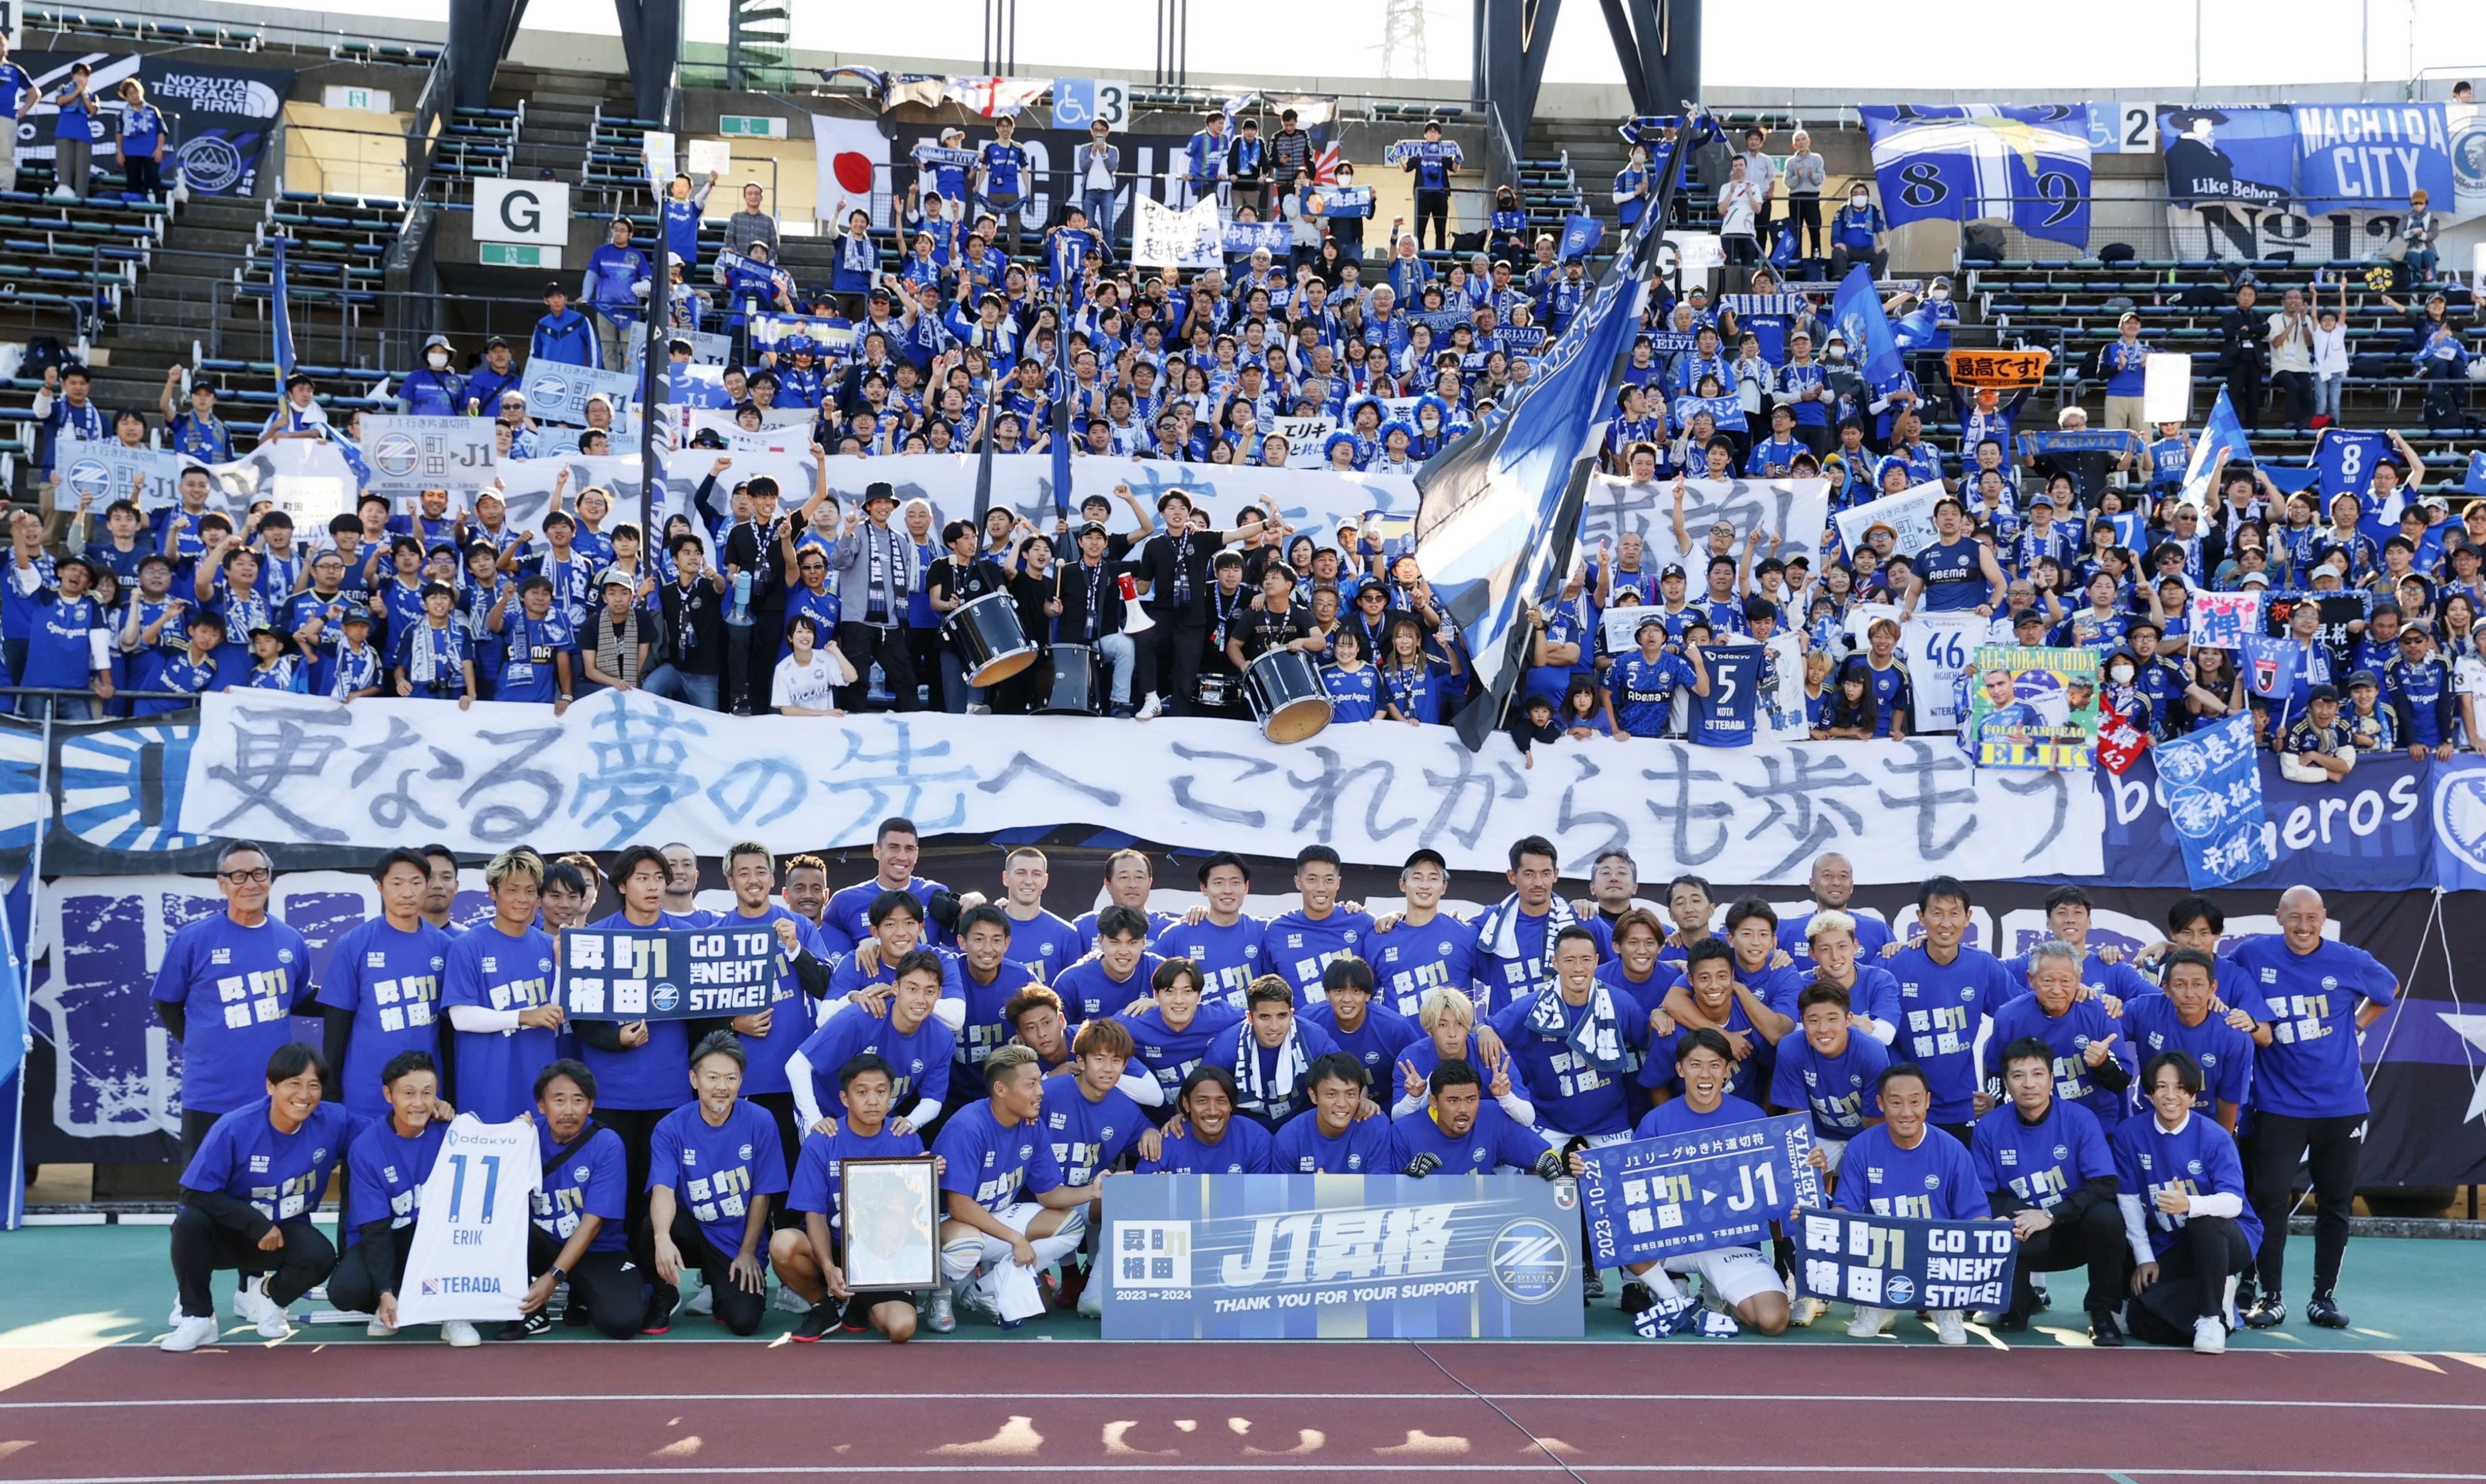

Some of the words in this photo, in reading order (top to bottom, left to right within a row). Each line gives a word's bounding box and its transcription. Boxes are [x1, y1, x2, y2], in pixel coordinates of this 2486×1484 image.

[151, 81, 246, 102] TERRACE
[165, 73, 247, 91] NOZUTA
[192, 98, 245, 115] FIRM
[1100, 87, 1123, 122] 3
[2126, 110, 2149, 146] 2
[2299, 108, 2448, 158] MACHIDA
[2333, 146, 2420, 197] CITY
[1900, 163, 1948, 207] 8
[2192, 178, 2229, 195] Like
[2036, 171, 2080, 227] 9
[501, 190, 540, 232] G
[1360, 206, 1369, 215] 22
[1140, 237, 1219, 263] 超絶幸せ
[755, 316, 780, 345] 16
[1493, 328, 1541, 340] ZELVIA
[1653, 339, 1699, 350] ELVI
[1955, 357, 2040, 378] 最高です!
[571, 381, 591, 412] 町田
[787, 382, 816, 393] Cybergent
[682, 393, 709, 408] J1
[1395, 406, 1411, 423] 荒
[1284, 423, 1327, 439] エリキ
[426, 436, 445, 474] 町田
[460, 444, 494, 467] J1
[1290, 443, 1326, 456] と共に
[2160, 454, 2187, 467] ERIK
[2341, 444, 2362, 475] 8
[148, 477, 179, 501] J1
[2344, 475, 2356, 484] LEO
[1828, 502, 1836, 531] ELVIA
[1895, 517, 1918, 549] 町田
[2113, 514, 2134, 547] 7
[118, 576, 141, 588] EMA
[1929, 568, 1967, 581] ABEMA
[2272, 601, 2292, 621] 祝
[2193, 631, 2206, 645] 16
[2248, 636, 2293, 652] いくぞ!
[507, 645, 551, 658] AMA
[1926, 631, 1965, 669] 46
[1977, 650, 2002, 670] ALL
[2005, 650, 2031, 670] FOR
[2033, 650, 2096, 672] MACHIDA
[2260, 650, 2275, 661] J1
[1717, 665, 1737, 704] 5
[1933, 672, 1960, 681] HIGUCHI
[791, 687, 829, 700] SVOLME
[1332, 693, 1371, 703] CyberAgent
[1717, 707, 1734, 717] KOTA
[1938, 707, 1956, 717] TERA
[1715, 720, 1745, 731] TERADA
[2021, 725, 2086, 738] CAMPEAO
[1978, 742, 2092, 767] ELIK
[2102, 749, 2126, 771] 42
[205, 691, 1121, 850] 更なる夢の先へ
[1170, 740, 2069, 882] これからも歩もう
[690, 935, 720, 958] GO
[732, 933, 769, 956] TO
[690, 962, 702, 984] THE
[701, 959, 768, 984] NEXT
[689, 985, 766, 1011] STAGE!
[460, 1135, 517, 1146] odakyu
[1625, 1155, 1640, 1168] J1
[1646, 1132, 1765, 1166] リーグゆき片道切符
[1785, 1129, 1801, 1180] MACHIDA
[1792, 1123, 1820, 1209] ZELVIA
[449, 1154, 501, 1224] 11
[1727, 1161, 1779, 1212] J1
[1794, 1181, 1803, 1196] FC
[1587, 1158, 1616, 1259] 2023.-10-22
[453, 1230, 482, 1247] ERIK
[1217, 1203, 1460, 1289] J1昇格
[1633, 1232, 1704, 1253] 発売日当日限り有効
[1711, 1223, 1759, 1239] 下車前途無効
[1928, 1228, 1959, 1253] GO
[1977, 1229, 2012, 1253] TO
[1504, 1270, 1556, 1284] ZELVIA
[1927, 1257, 1940, 1280] THE
[1939, 1256, 2007, 1282] NEXT
[441, 1276, 501, 1294] TERADA
[1116, 1290, 1147, 1300] 2023
[1161, 1290, 1192, 1300] 2024
[1925, 1281, 2004, 1308] STAGE!
[1214, 1295, 1271, 1314] THANK
[1277, 1292, 1311, 1309] YOU
[1314, 1289, 1349, 1306] FOR
[1351, 1285, 1398, 1302] YOUR
[1401, 1280, 1479, 1299] SUPPORT
